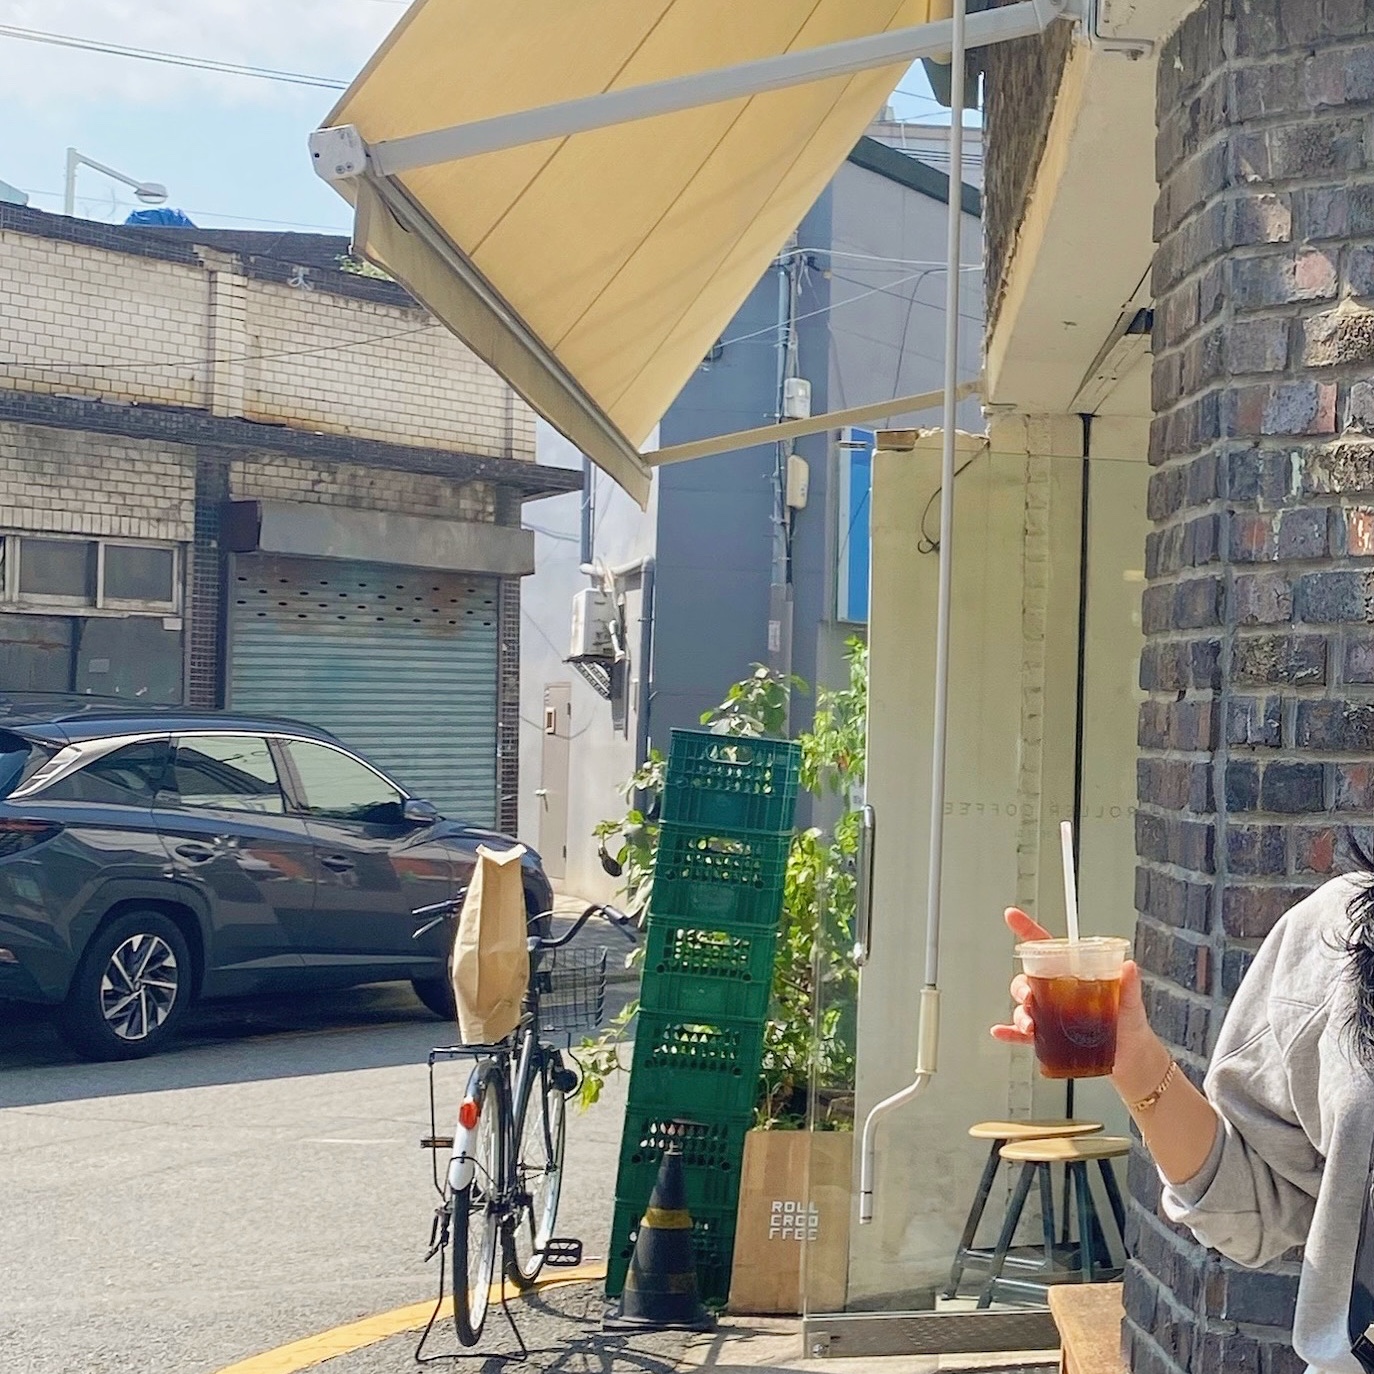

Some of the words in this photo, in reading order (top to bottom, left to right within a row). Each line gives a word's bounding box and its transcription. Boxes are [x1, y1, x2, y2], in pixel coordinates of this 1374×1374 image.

[771, 1201, 819, 1214] ROLL
[770, 1214, 819, 1227] ERCO
[768, 1228, 818, 1241] FFEE
